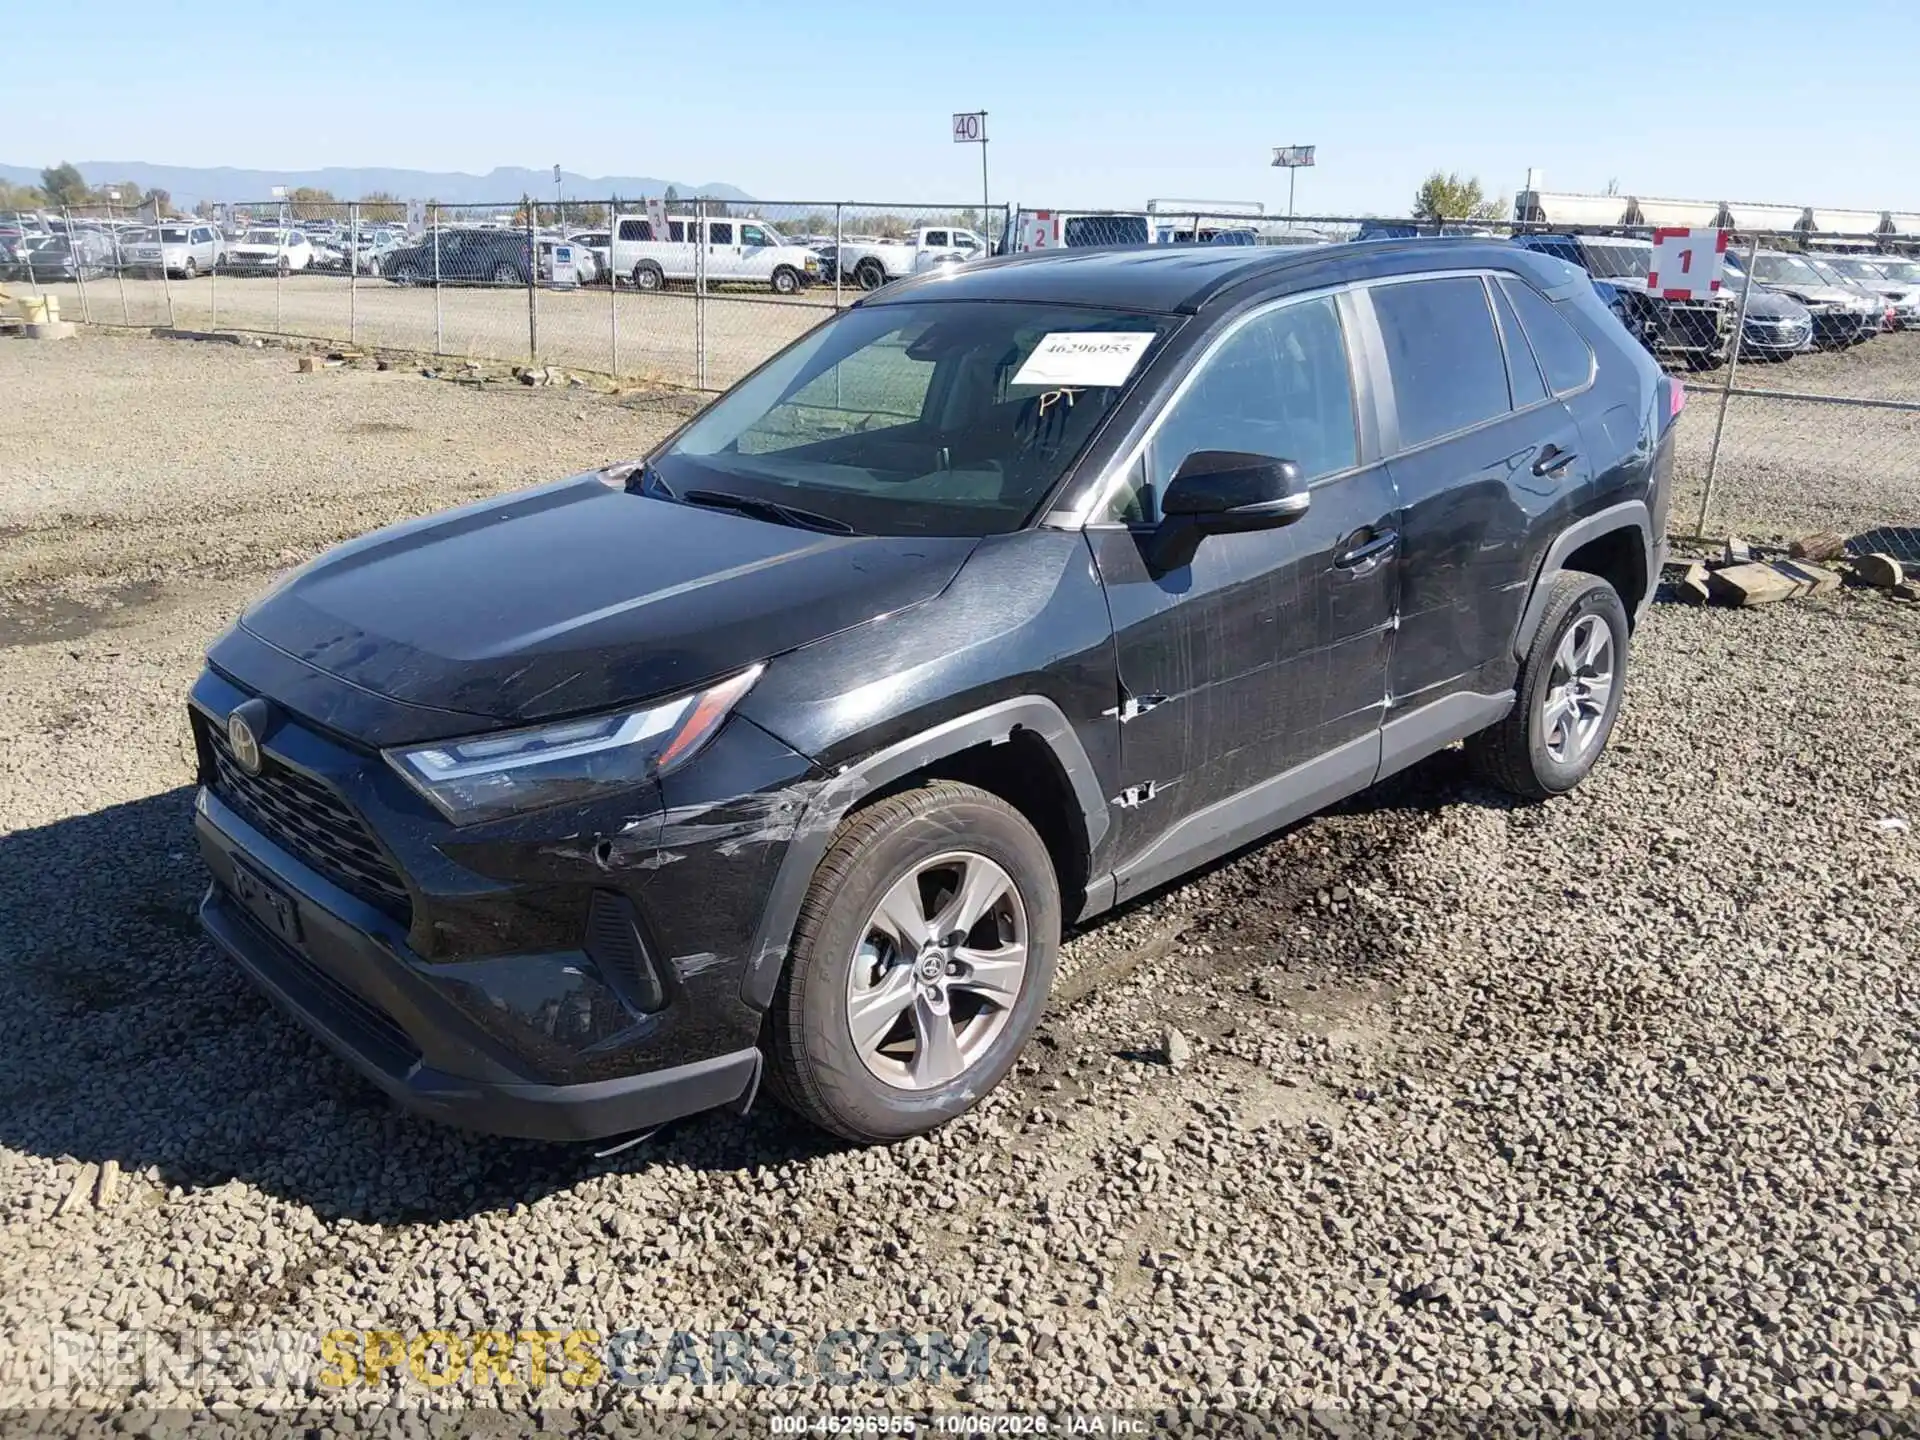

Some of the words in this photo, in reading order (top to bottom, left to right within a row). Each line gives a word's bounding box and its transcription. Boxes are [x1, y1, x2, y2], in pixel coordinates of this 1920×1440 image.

[956, 116, 977, 139] 40
[654, 213, 661, 228] 3
[1036, 228, 1045, 247] 2
[1678, 249, 1692, 273] 1
[1045, 343, 1132, 354] 46296955
[1040, 388, 1087, 416] PT
